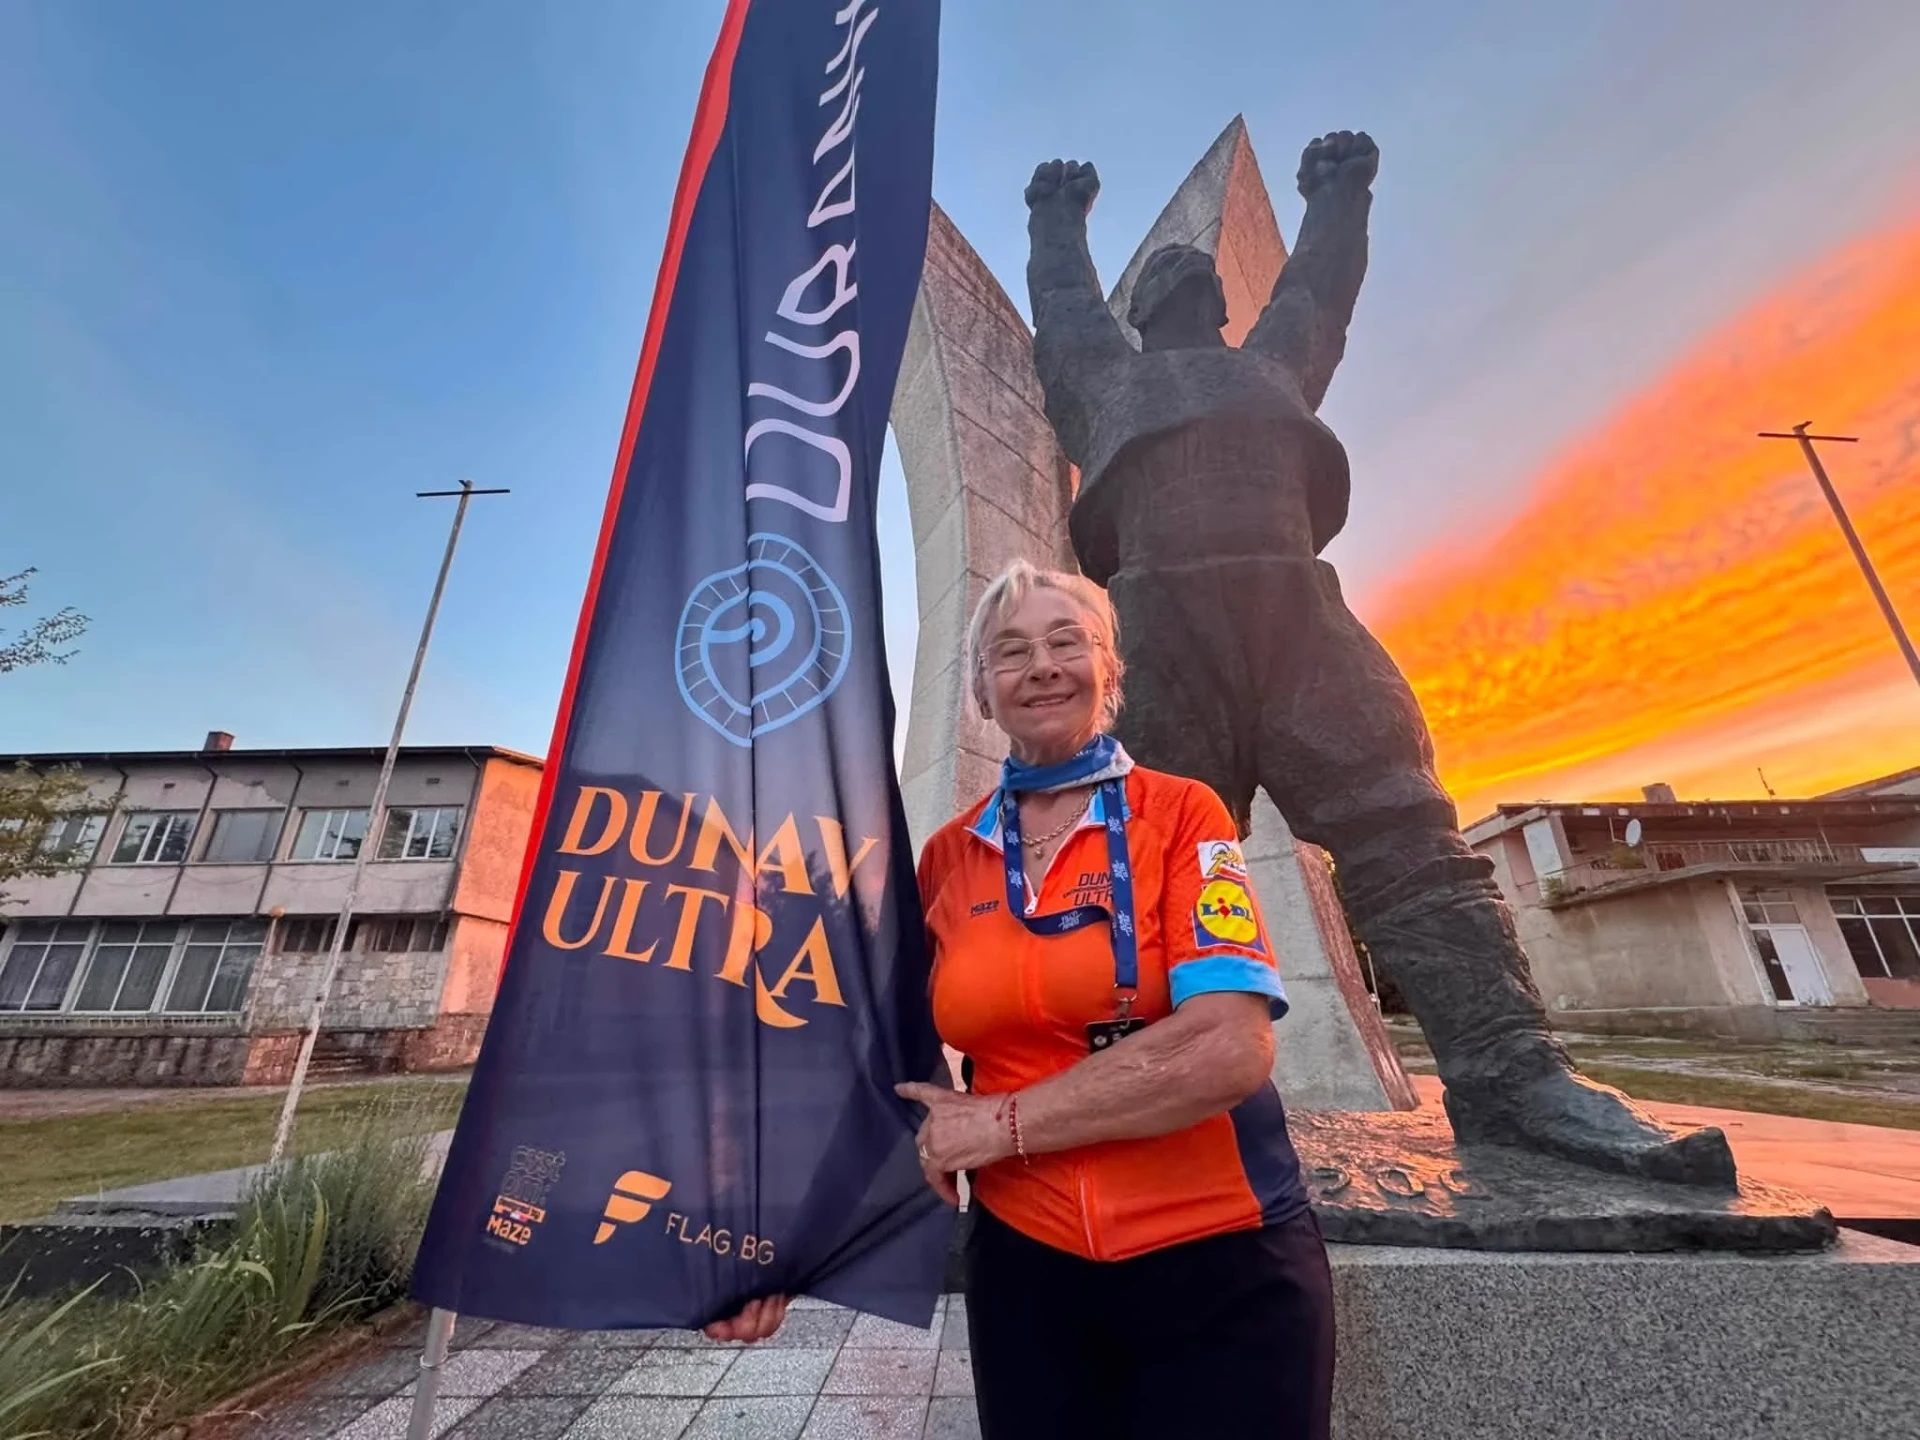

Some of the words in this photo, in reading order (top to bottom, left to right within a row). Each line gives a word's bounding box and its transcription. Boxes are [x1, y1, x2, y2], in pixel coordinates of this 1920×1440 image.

[556, 786, 880, 900] DUNAV
[1073, 888, 1114, 906] ULTR
[1078, 872, 1113, 887] DUN
[542, 870, 848, 1028] ULTRA
[486, 1214, 532, 1246] Maze
[665, 1212, 775, 1265] FLAG.BG
